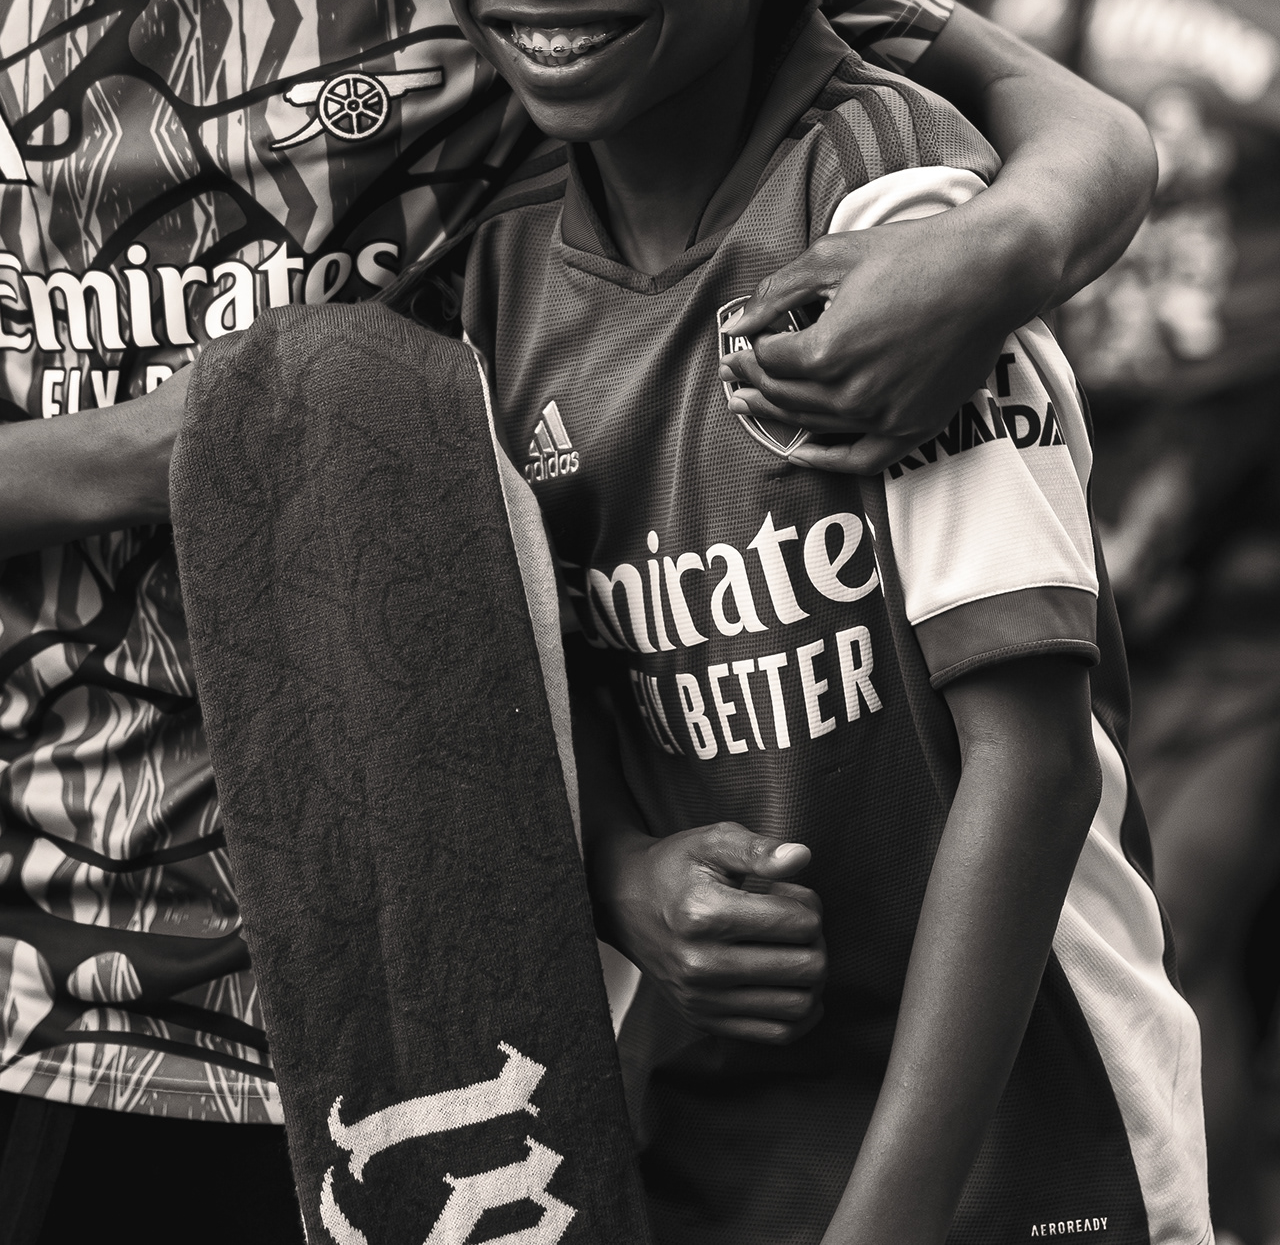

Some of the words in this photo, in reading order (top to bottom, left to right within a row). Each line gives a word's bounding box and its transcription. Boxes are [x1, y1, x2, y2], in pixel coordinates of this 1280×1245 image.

[524, 449, 580, 484] adidas
[560, 510, 885, 655] mirate
[675, 624, 884, 761] BETTER
[1030, 1216, 1108, 1237] AEROREADY
